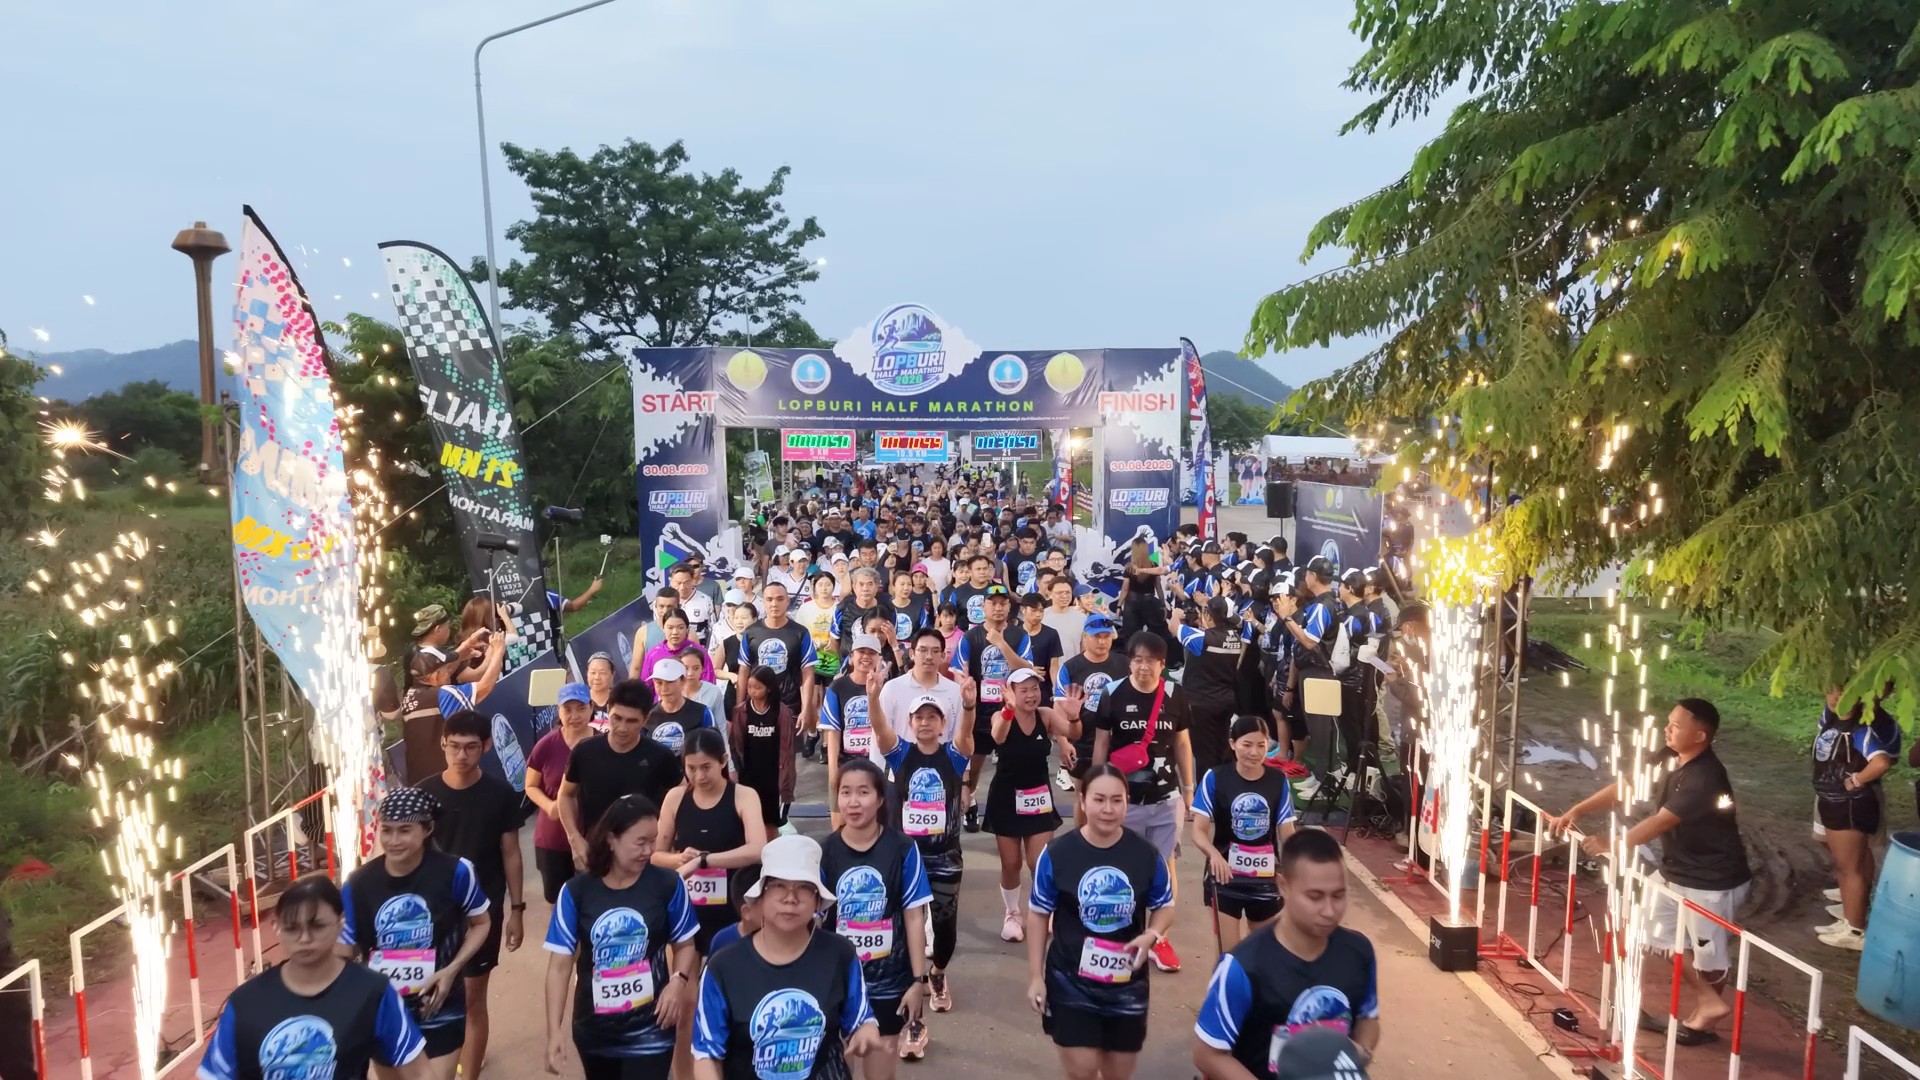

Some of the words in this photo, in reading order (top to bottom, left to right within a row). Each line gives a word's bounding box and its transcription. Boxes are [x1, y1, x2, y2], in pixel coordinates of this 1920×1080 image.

[873, 351, 945, 371] LOPBURI
[876, 369, 898, 379] HALF
[900, 366, 943, 376] MARATHON
[642, 393, 715, 413] START
[778, 399, 862, 412] LOPBURI
[871, 401, 918, 412] HALF
[928, 401, 1034, 412] MARATHON
[1100, 392, 1175, 412] FINISH
[1002, 448, 1011, 456] 21
[644, 465, 709, 475] 30.08.2026
[1111, 461, 1173, 471] 30.08.2026
[650, 491, 708, 504] LOPBURI
[1112, 489, 1168, 502] LOPBURI
[1120, 720, 1173, 730] GARIN
[1024, 796, 1046, 807] 5216
[908, 813, 938, 825] 5269
[1235, 855, 1268, 867] 5066
[687, 881, 716, 893] 5031
[838, 898, 887, 914] LOPBURI
[594, 943, 647, 960] LOPBURI
[602, 979, 643, 999] 5386
[755, 1036, 821, 1062] LOPBUR
[781, 1053, 816, 1064] MARATH
